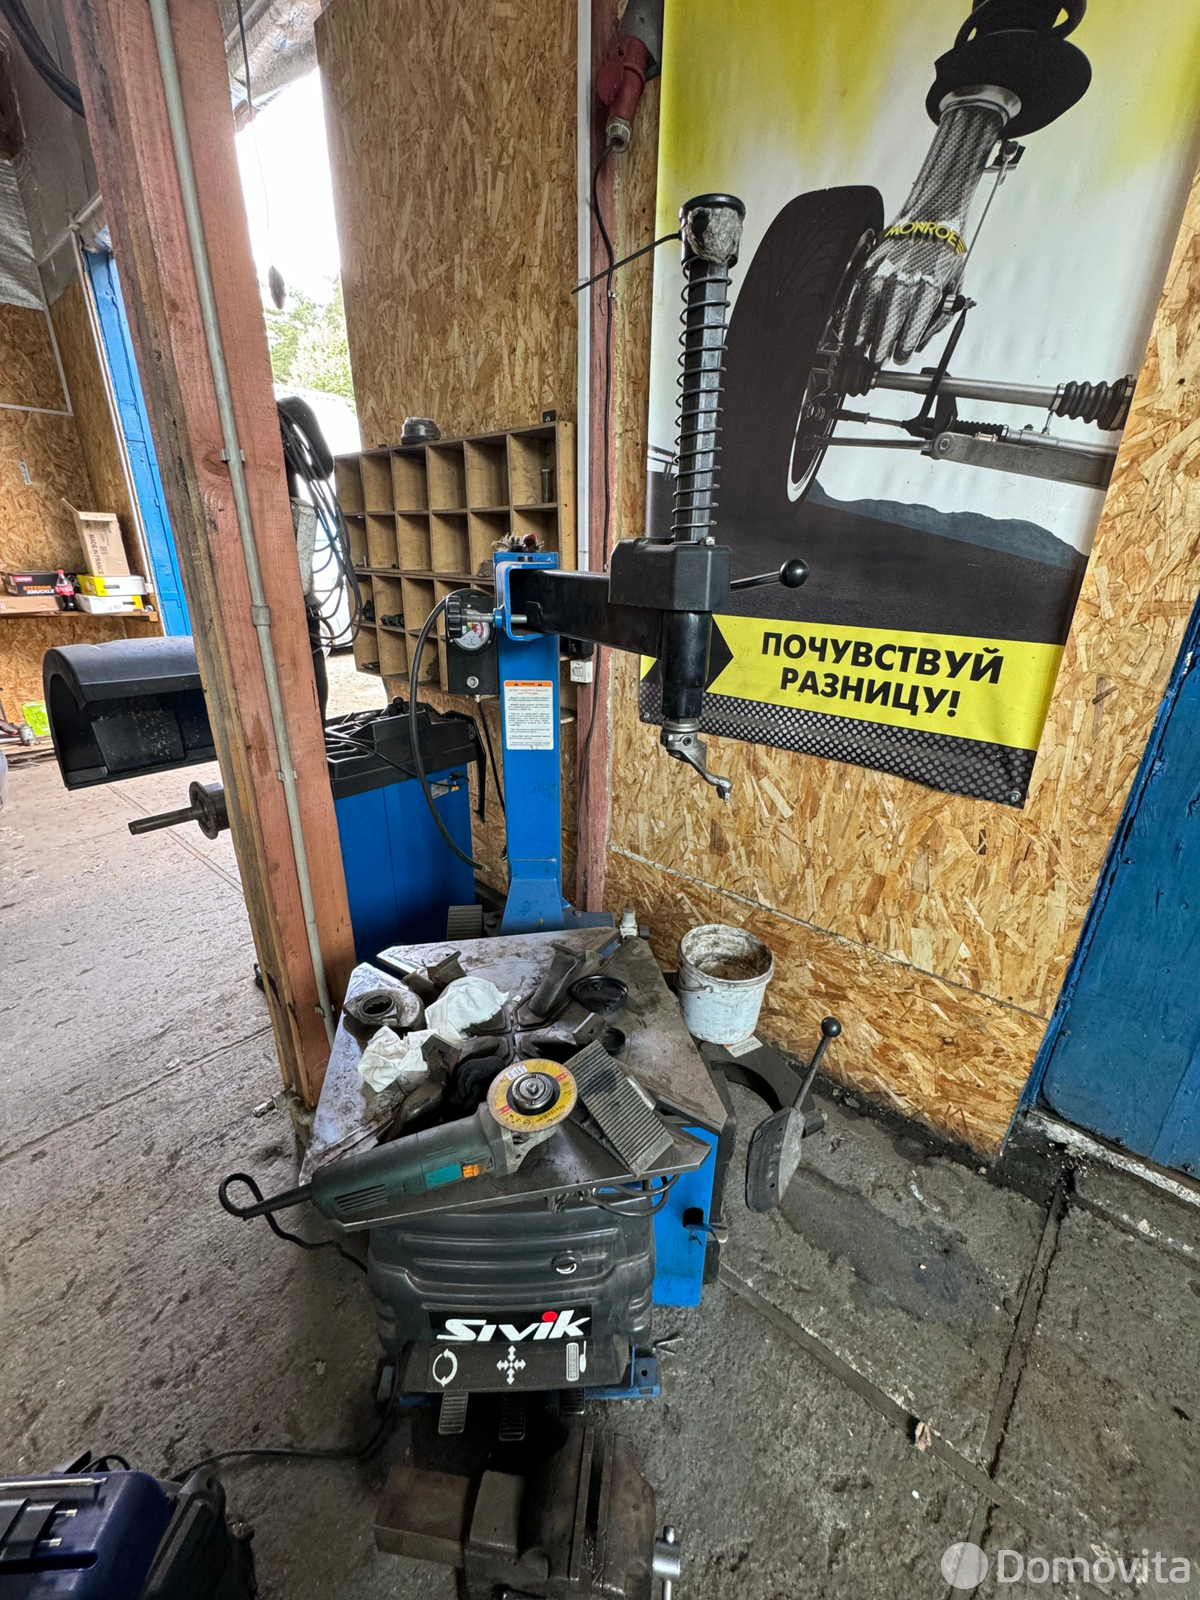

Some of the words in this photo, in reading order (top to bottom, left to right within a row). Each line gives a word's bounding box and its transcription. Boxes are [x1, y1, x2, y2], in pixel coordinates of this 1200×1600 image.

[884, 221, 958, 248] MONROE
[88, 534, 98, 549] MADE
[94, 555, 105, 575] FRANCE
[761, 631, 1004, 685] ПОЧУВСТВУЙ
[780, 666, 961, 718] РАЗНИЦУ!
